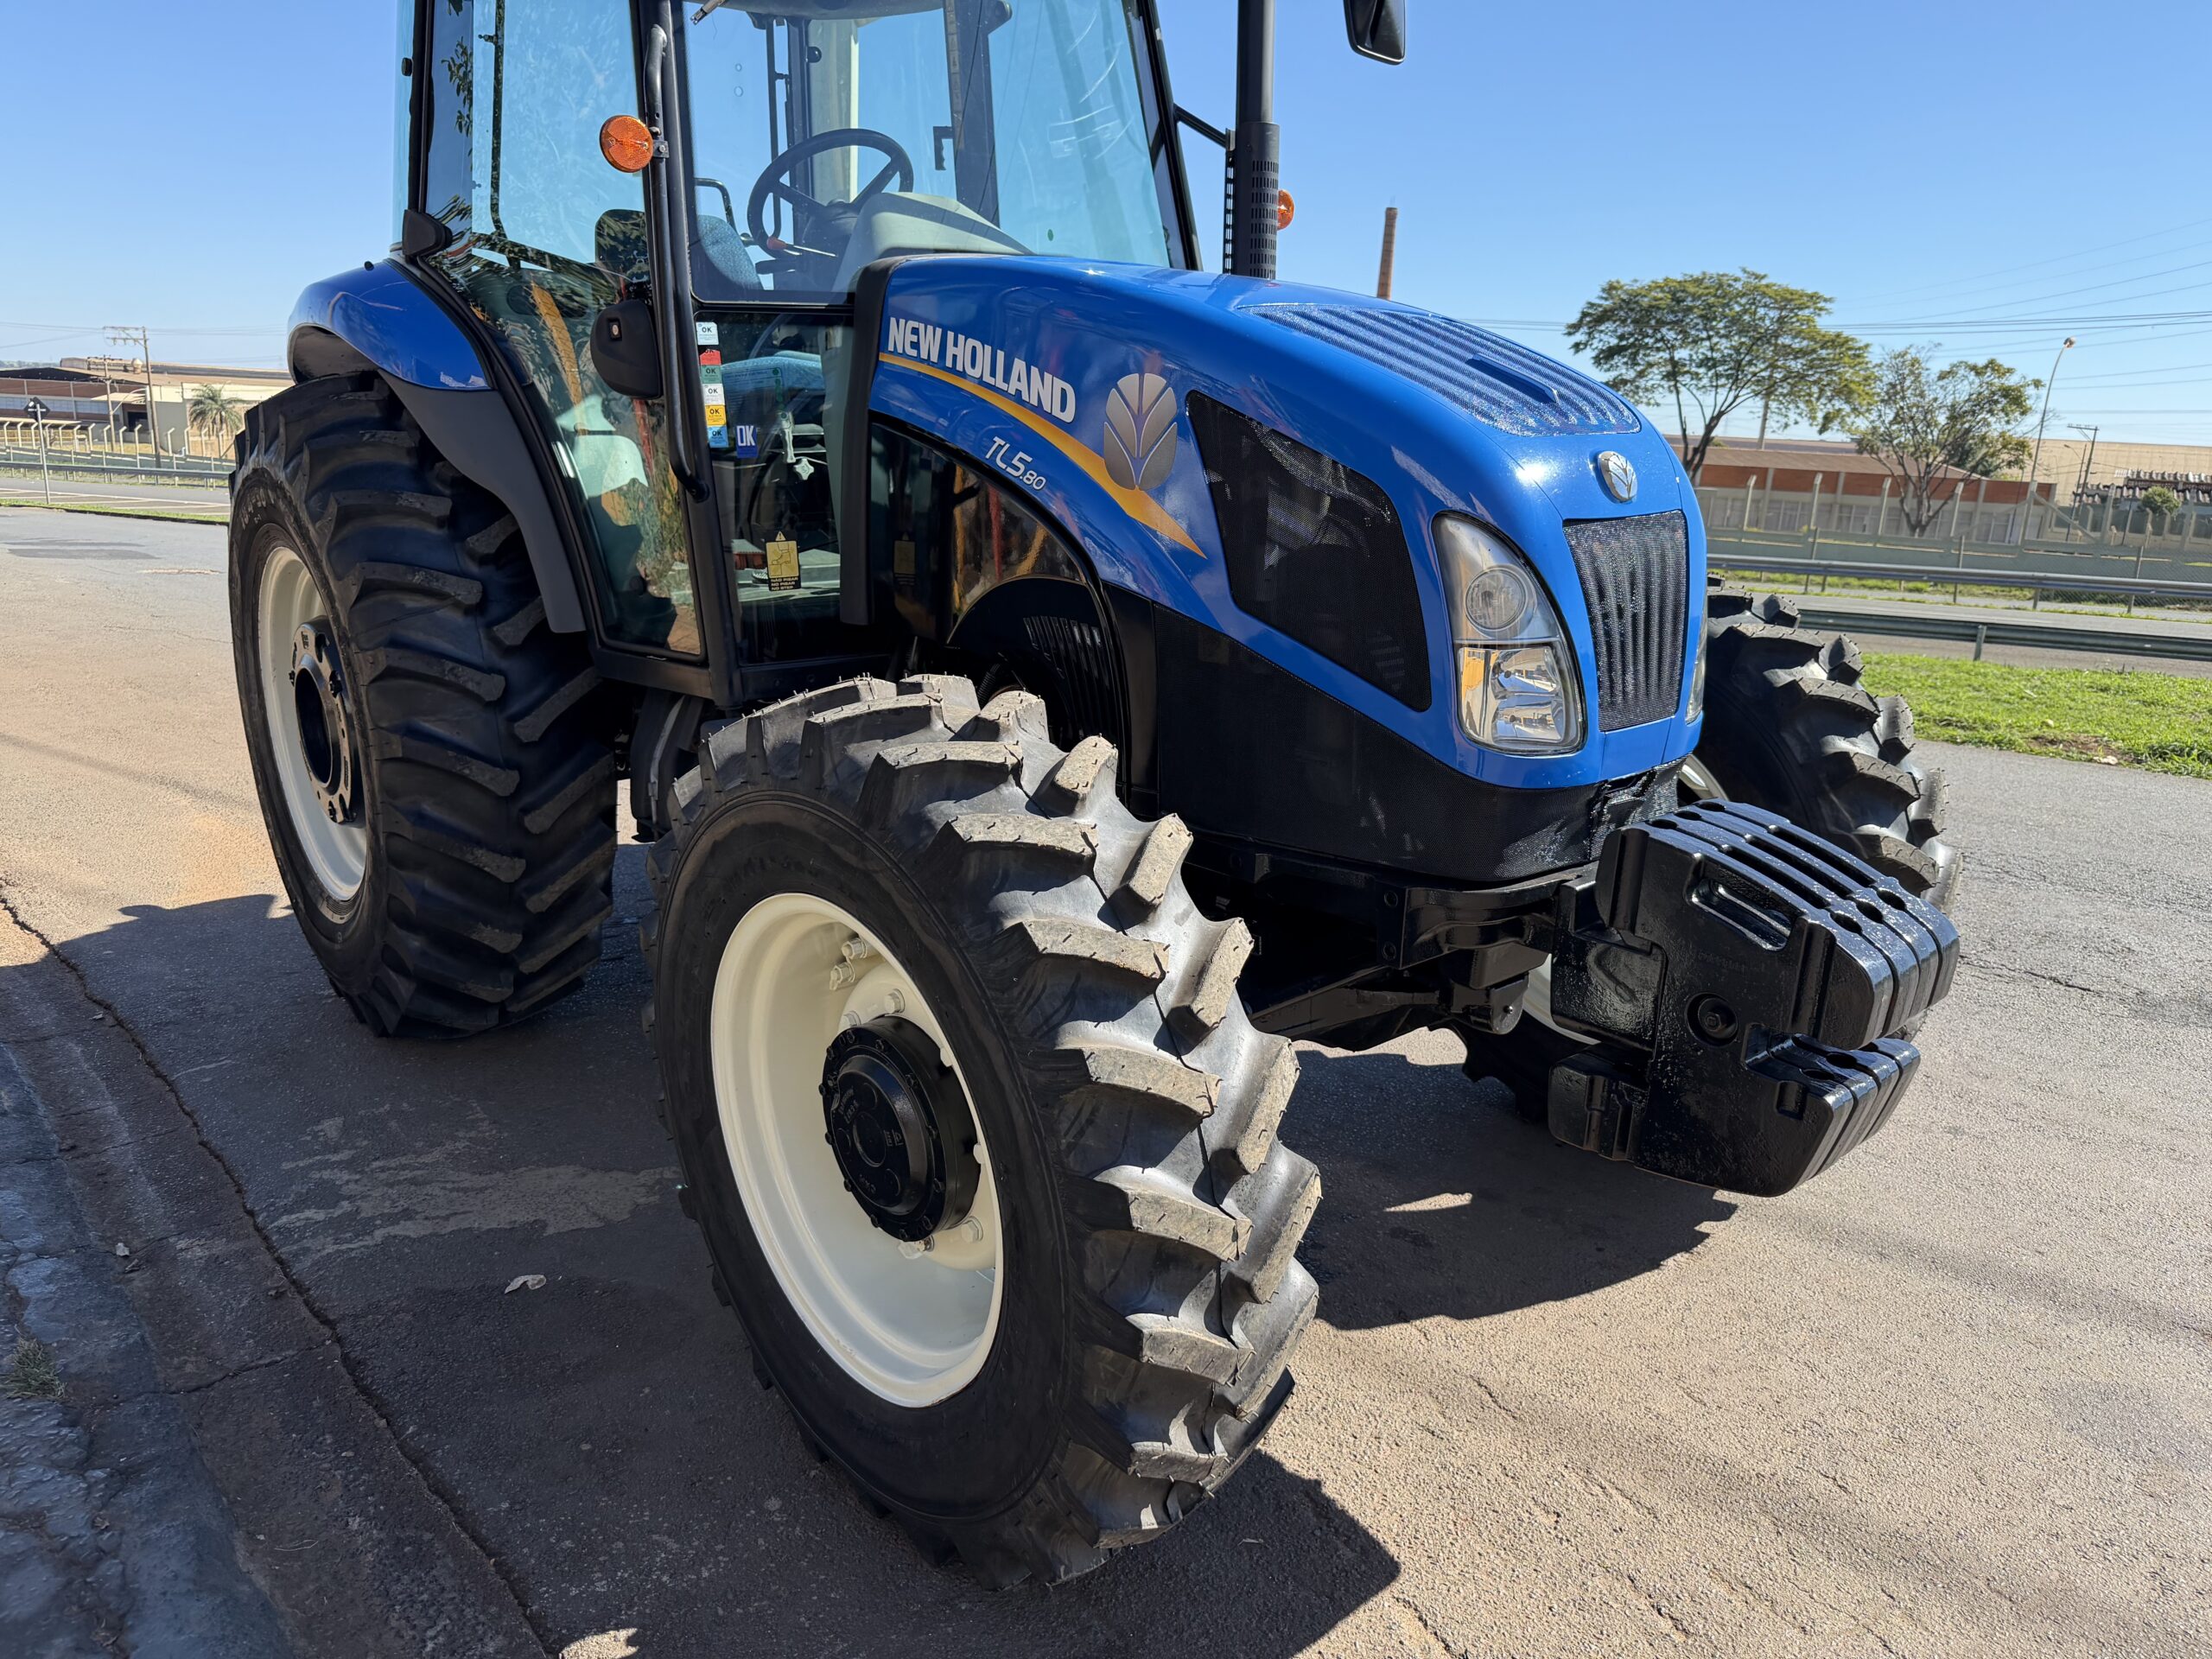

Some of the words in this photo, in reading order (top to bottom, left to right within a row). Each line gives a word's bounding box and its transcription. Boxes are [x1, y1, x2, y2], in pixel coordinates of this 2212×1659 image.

[887, 316, 943, 364] NEW
[945, 330, 1076, 423] HOLLAND
[736, 425, 756, 447] OK
[985, 435, 1046, 490] TL5.80
